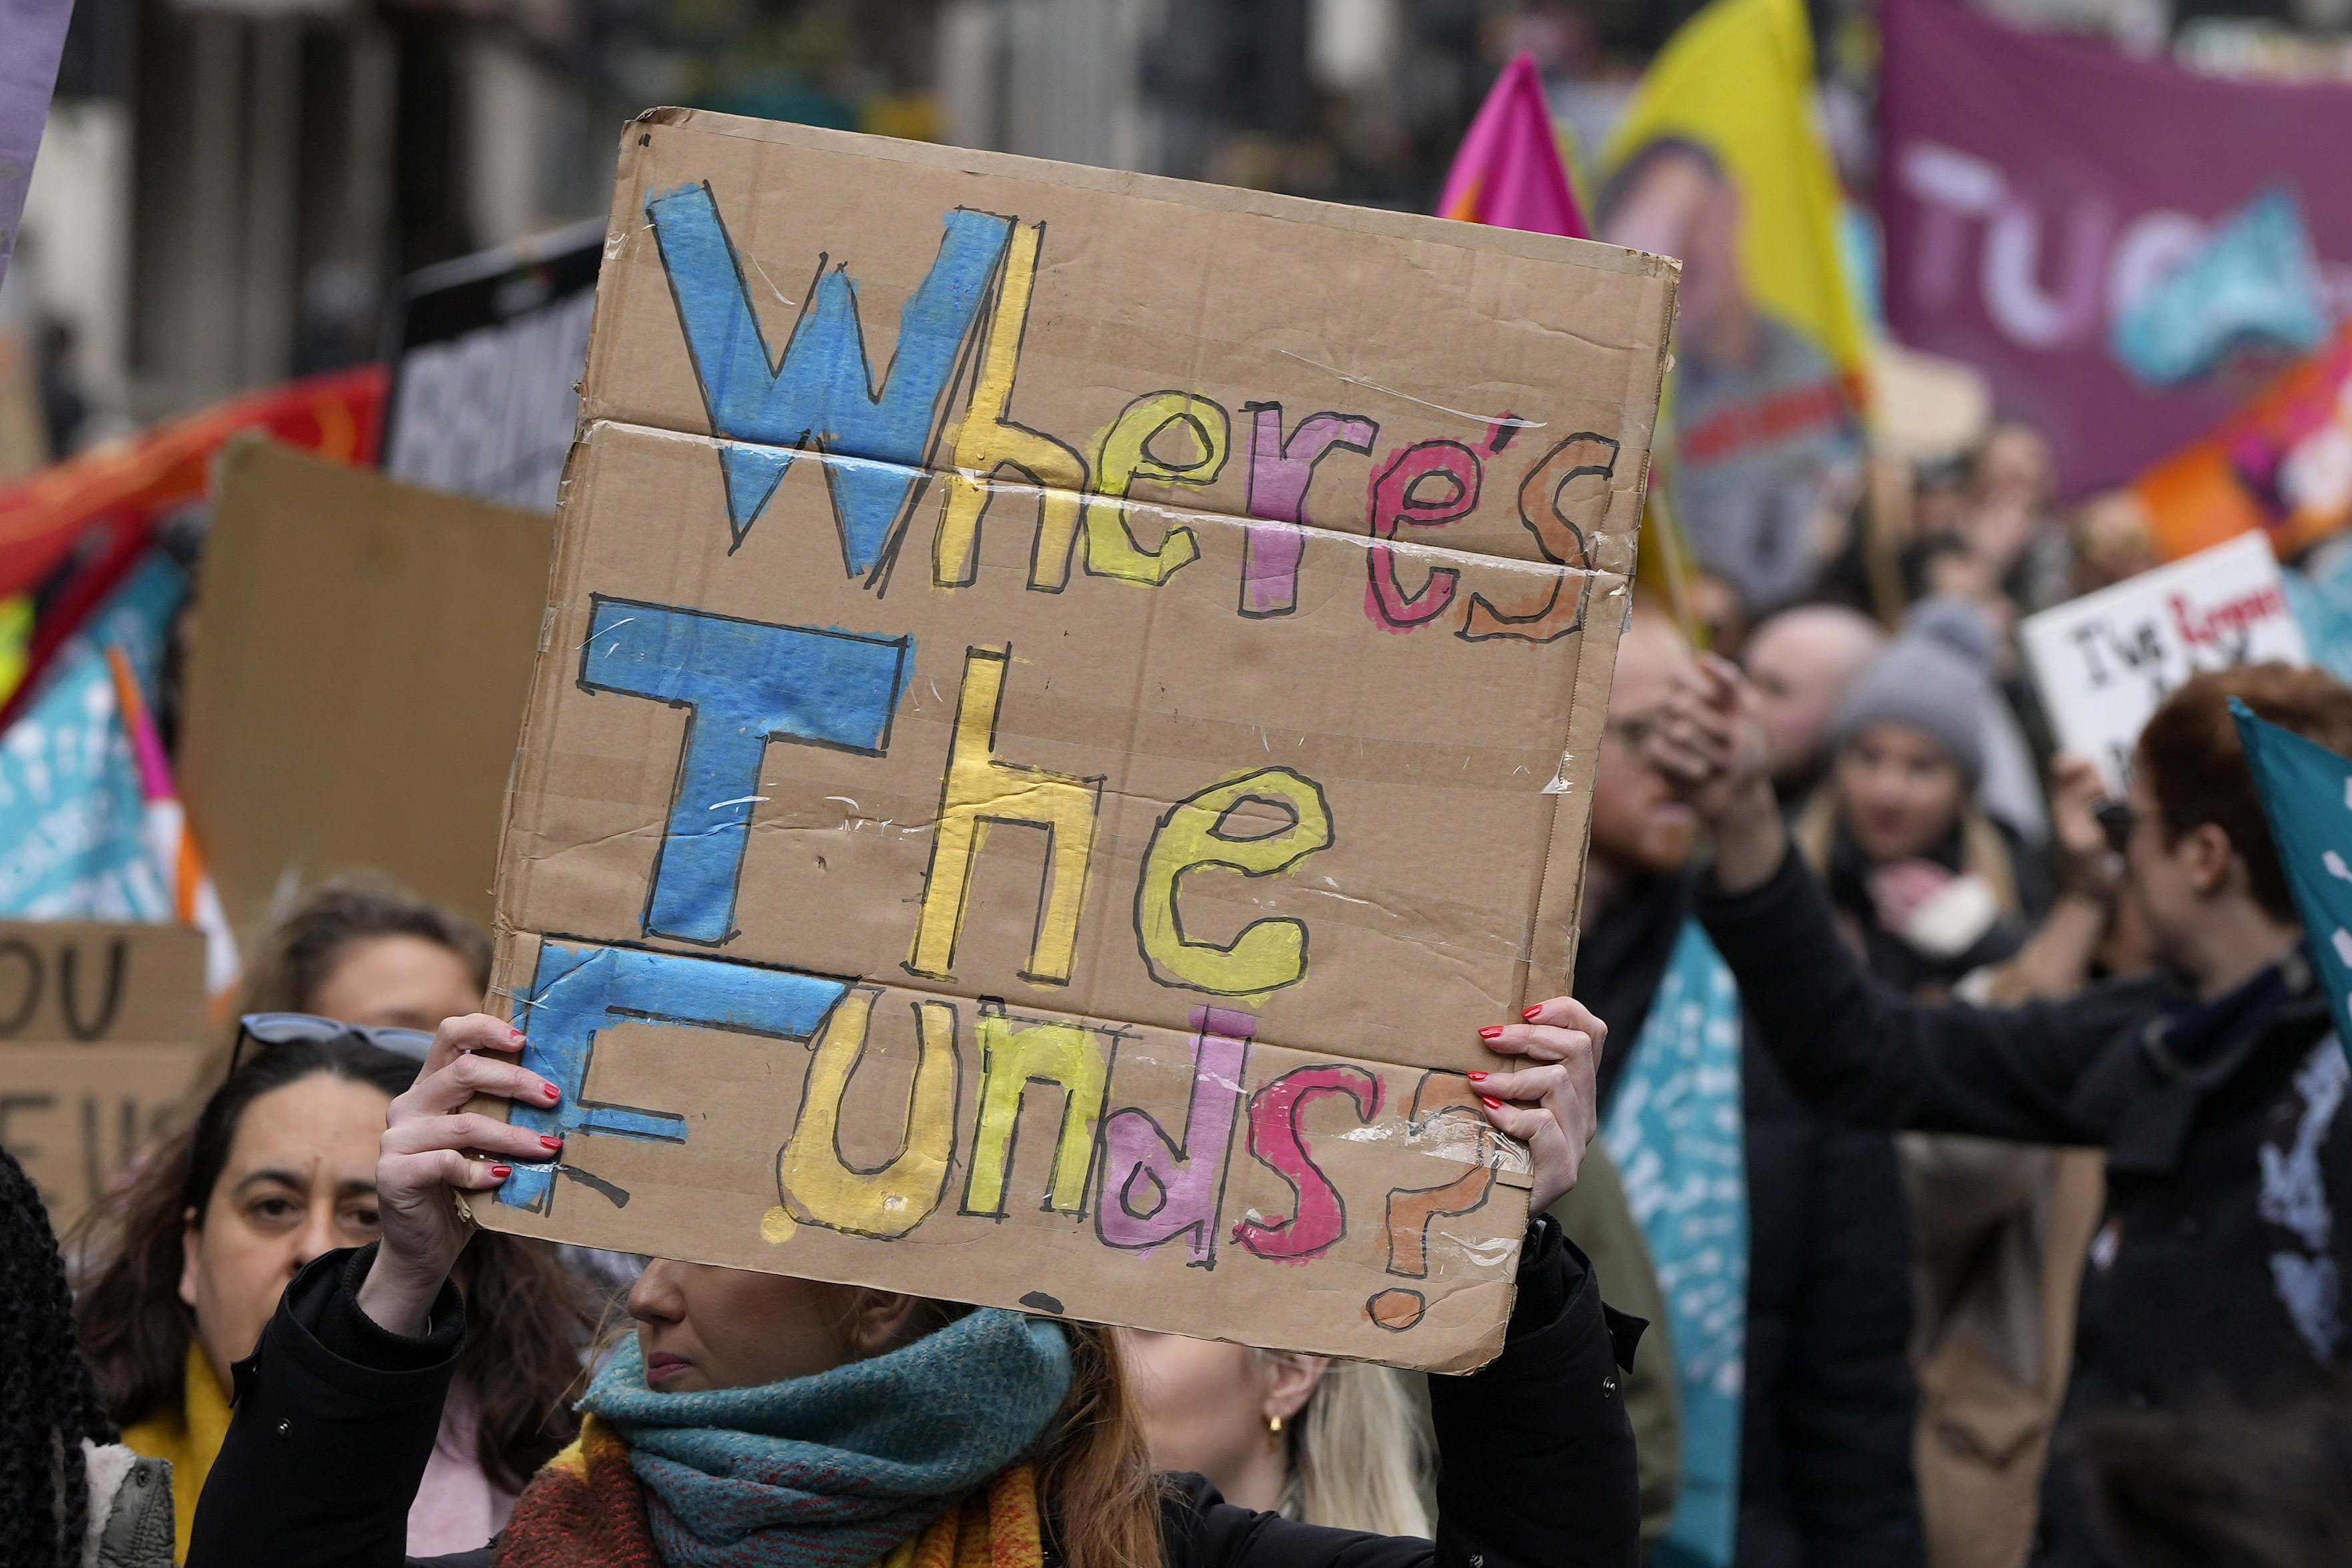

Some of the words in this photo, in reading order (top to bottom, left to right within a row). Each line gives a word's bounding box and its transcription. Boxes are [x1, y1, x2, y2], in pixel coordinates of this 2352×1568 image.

[646, 180, 1620, 643] Where's
[576, 592, 1335, 1000] The
[496, 933, 1500, 1333] Funds?
